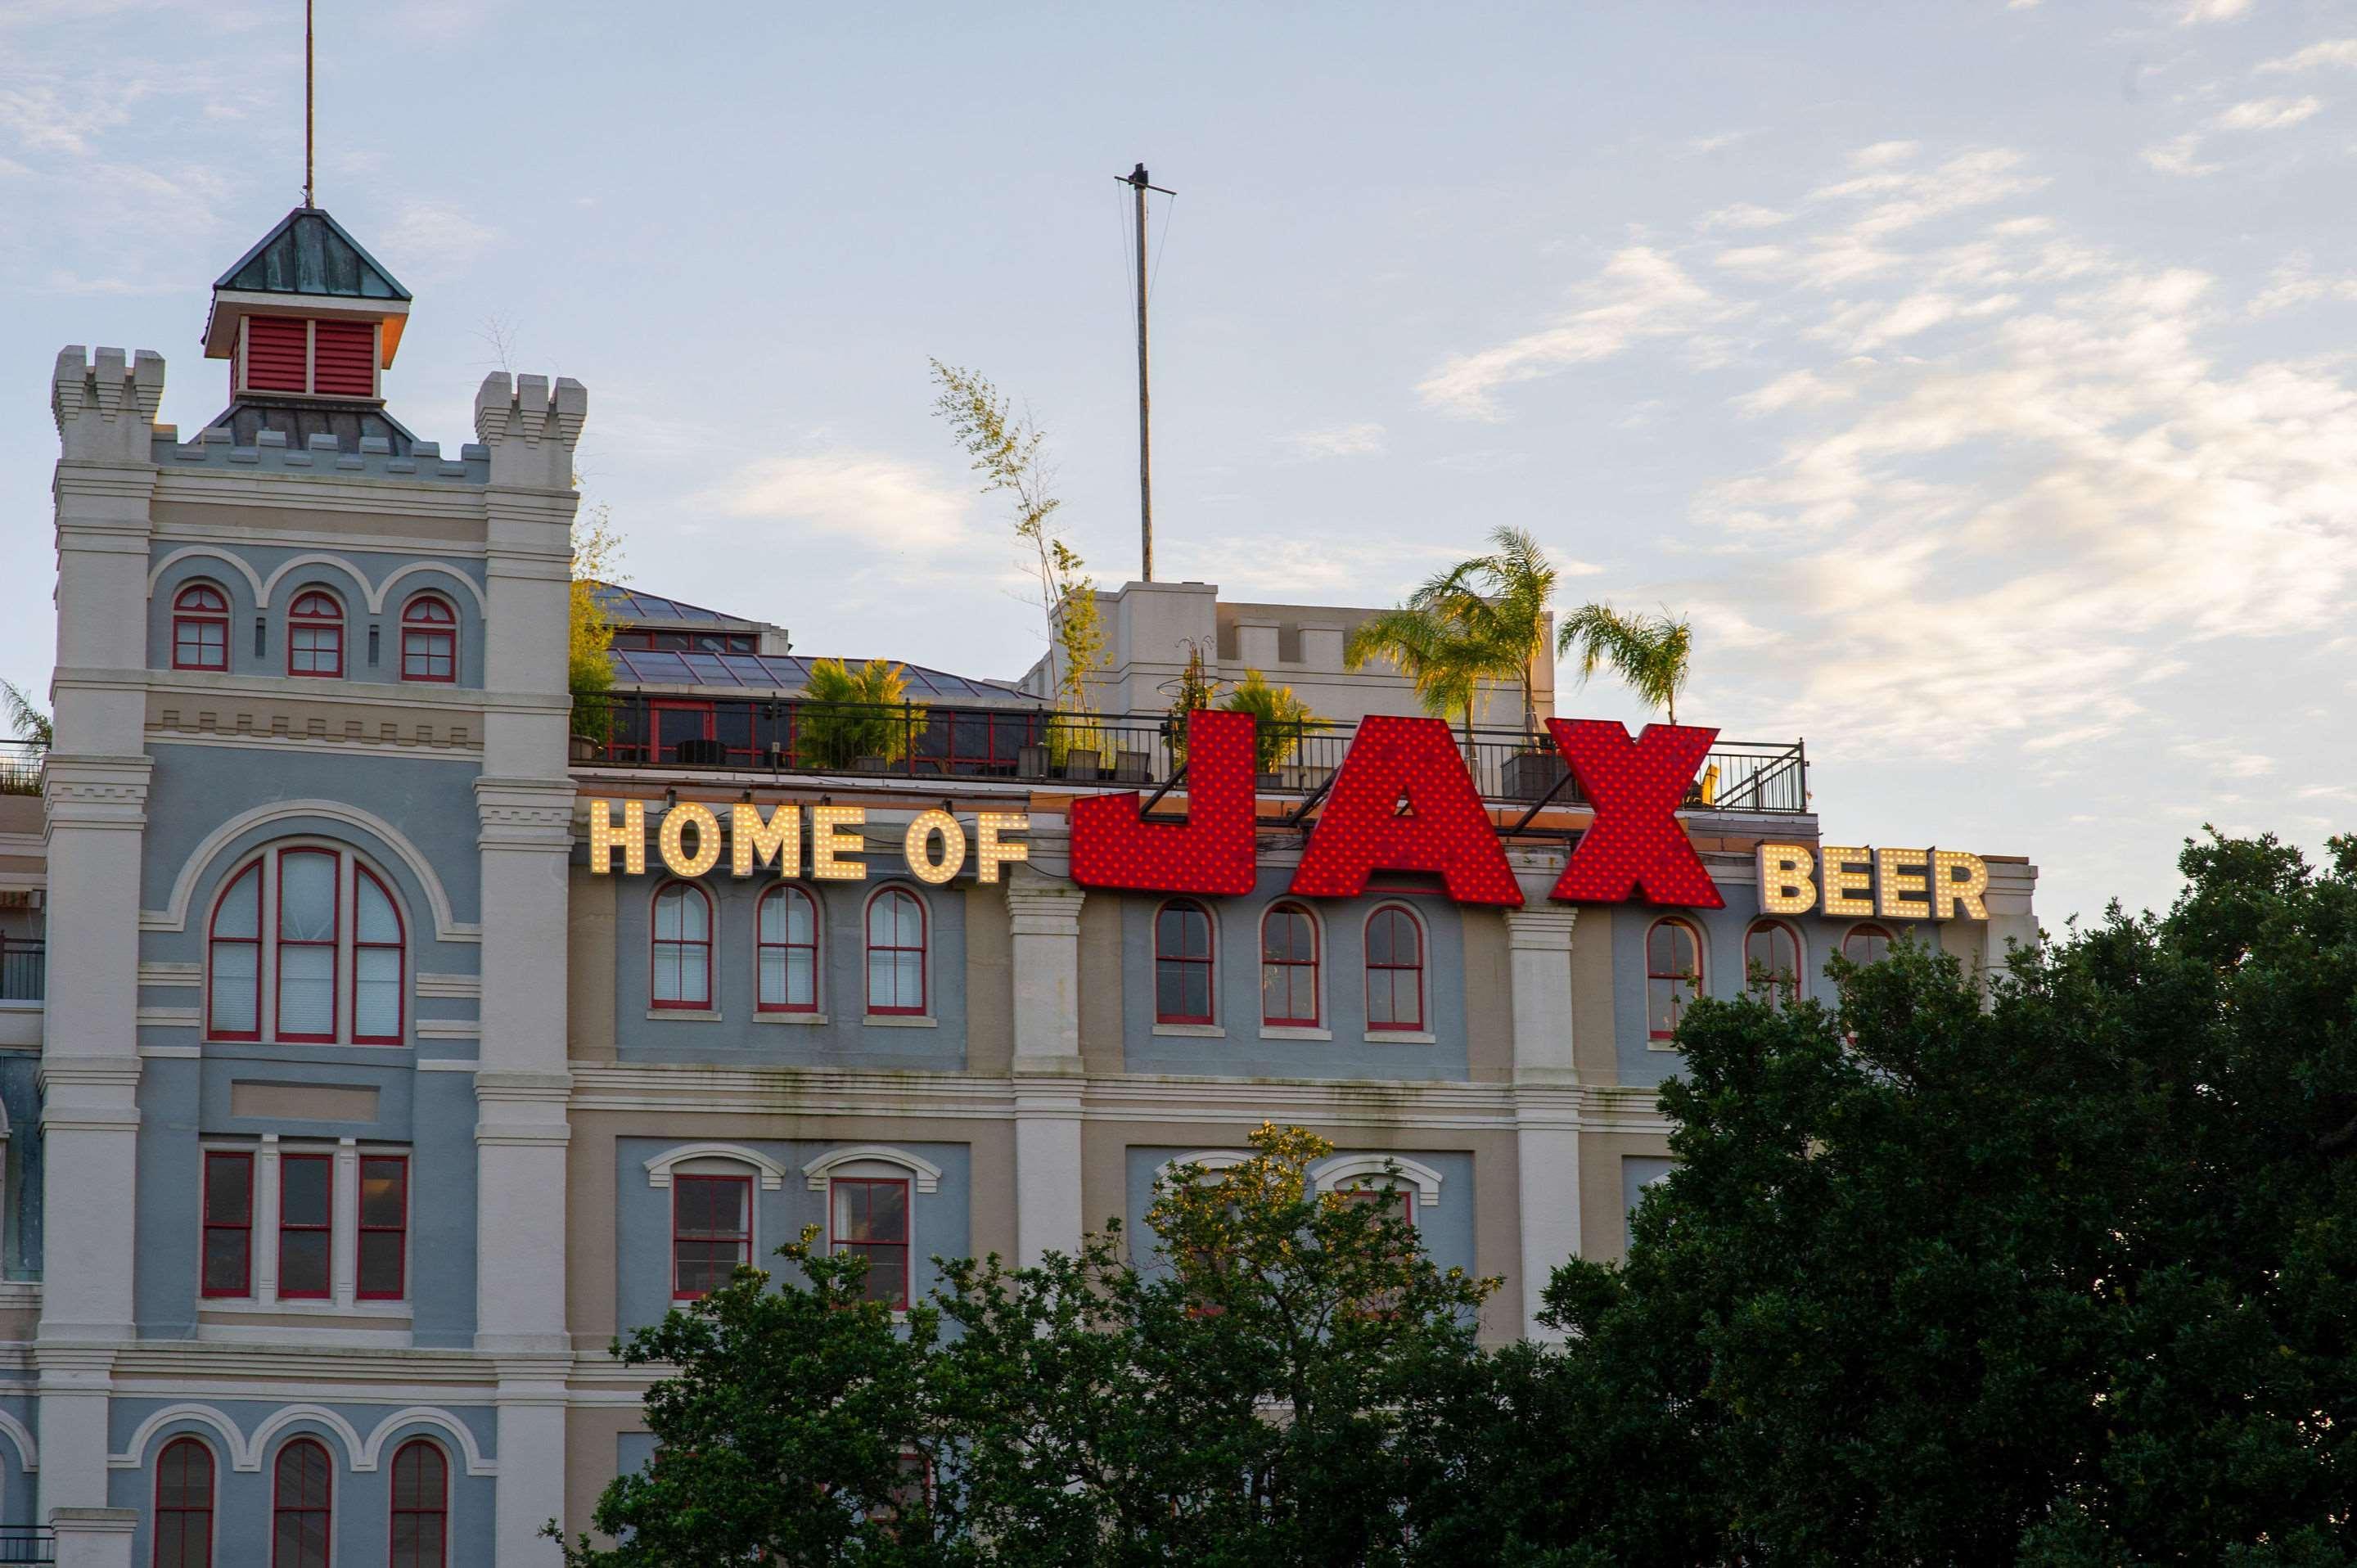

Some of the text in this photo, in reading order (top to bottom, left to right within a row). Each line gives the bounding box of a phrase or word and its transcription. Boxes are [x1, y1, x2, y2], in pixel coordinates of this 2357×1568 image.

[590, 709, 1990, 921] HOME OF JAX BEER
